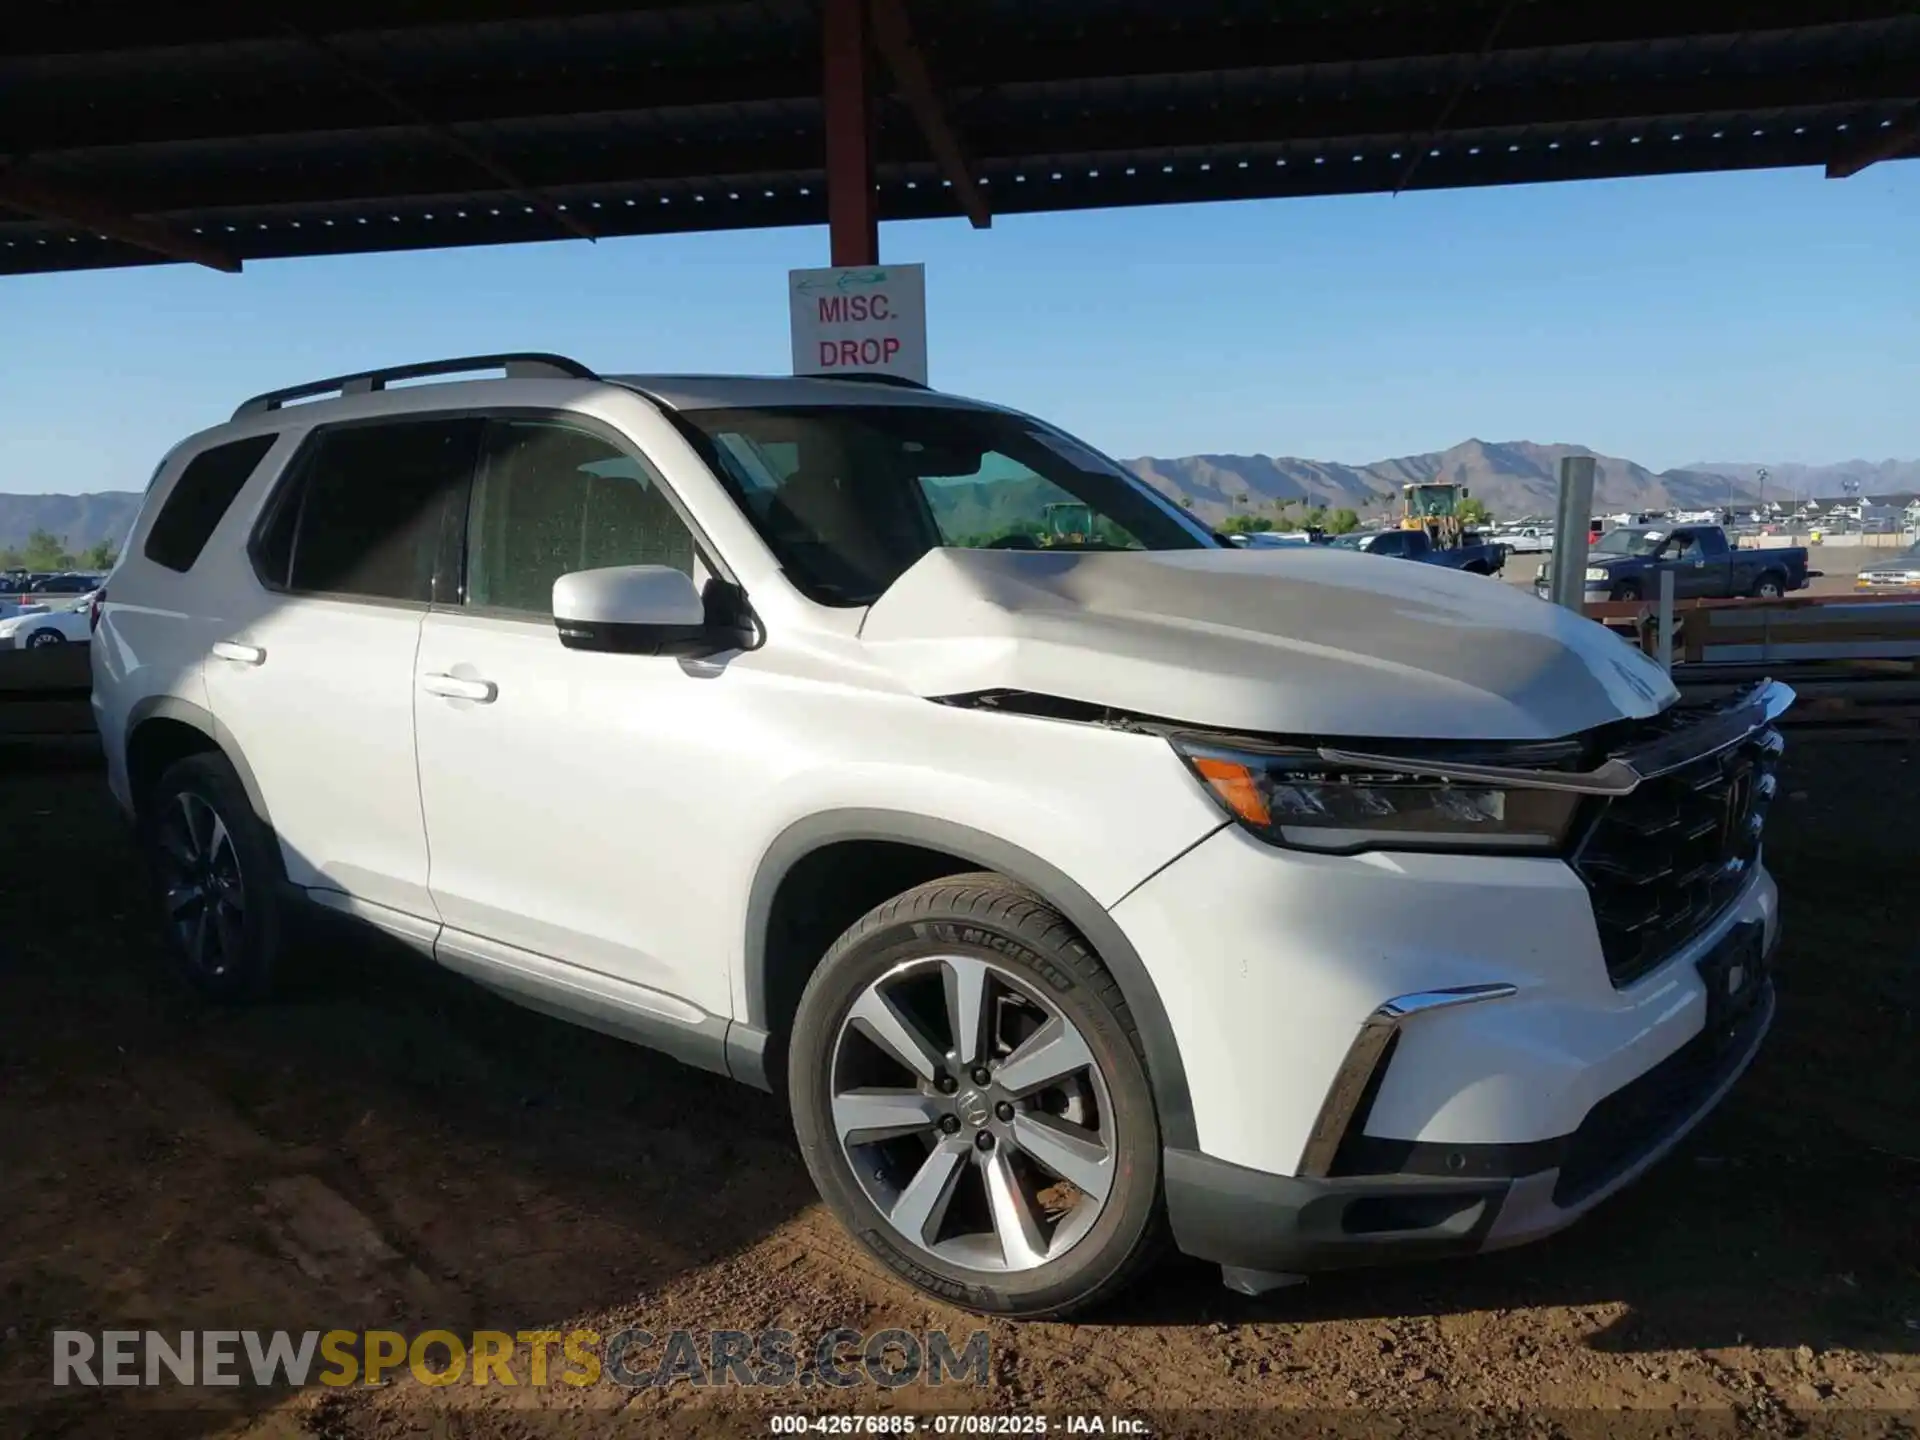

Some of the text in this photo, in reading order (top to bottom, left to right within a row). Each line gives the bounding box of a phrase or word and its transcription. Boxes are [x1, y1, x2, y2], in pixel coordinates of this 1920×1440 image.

[818, 294, 898, 323] MISC.
[819, 337, 901, 367] DROP
[962, 928, 1070, 991] MICHELIN
